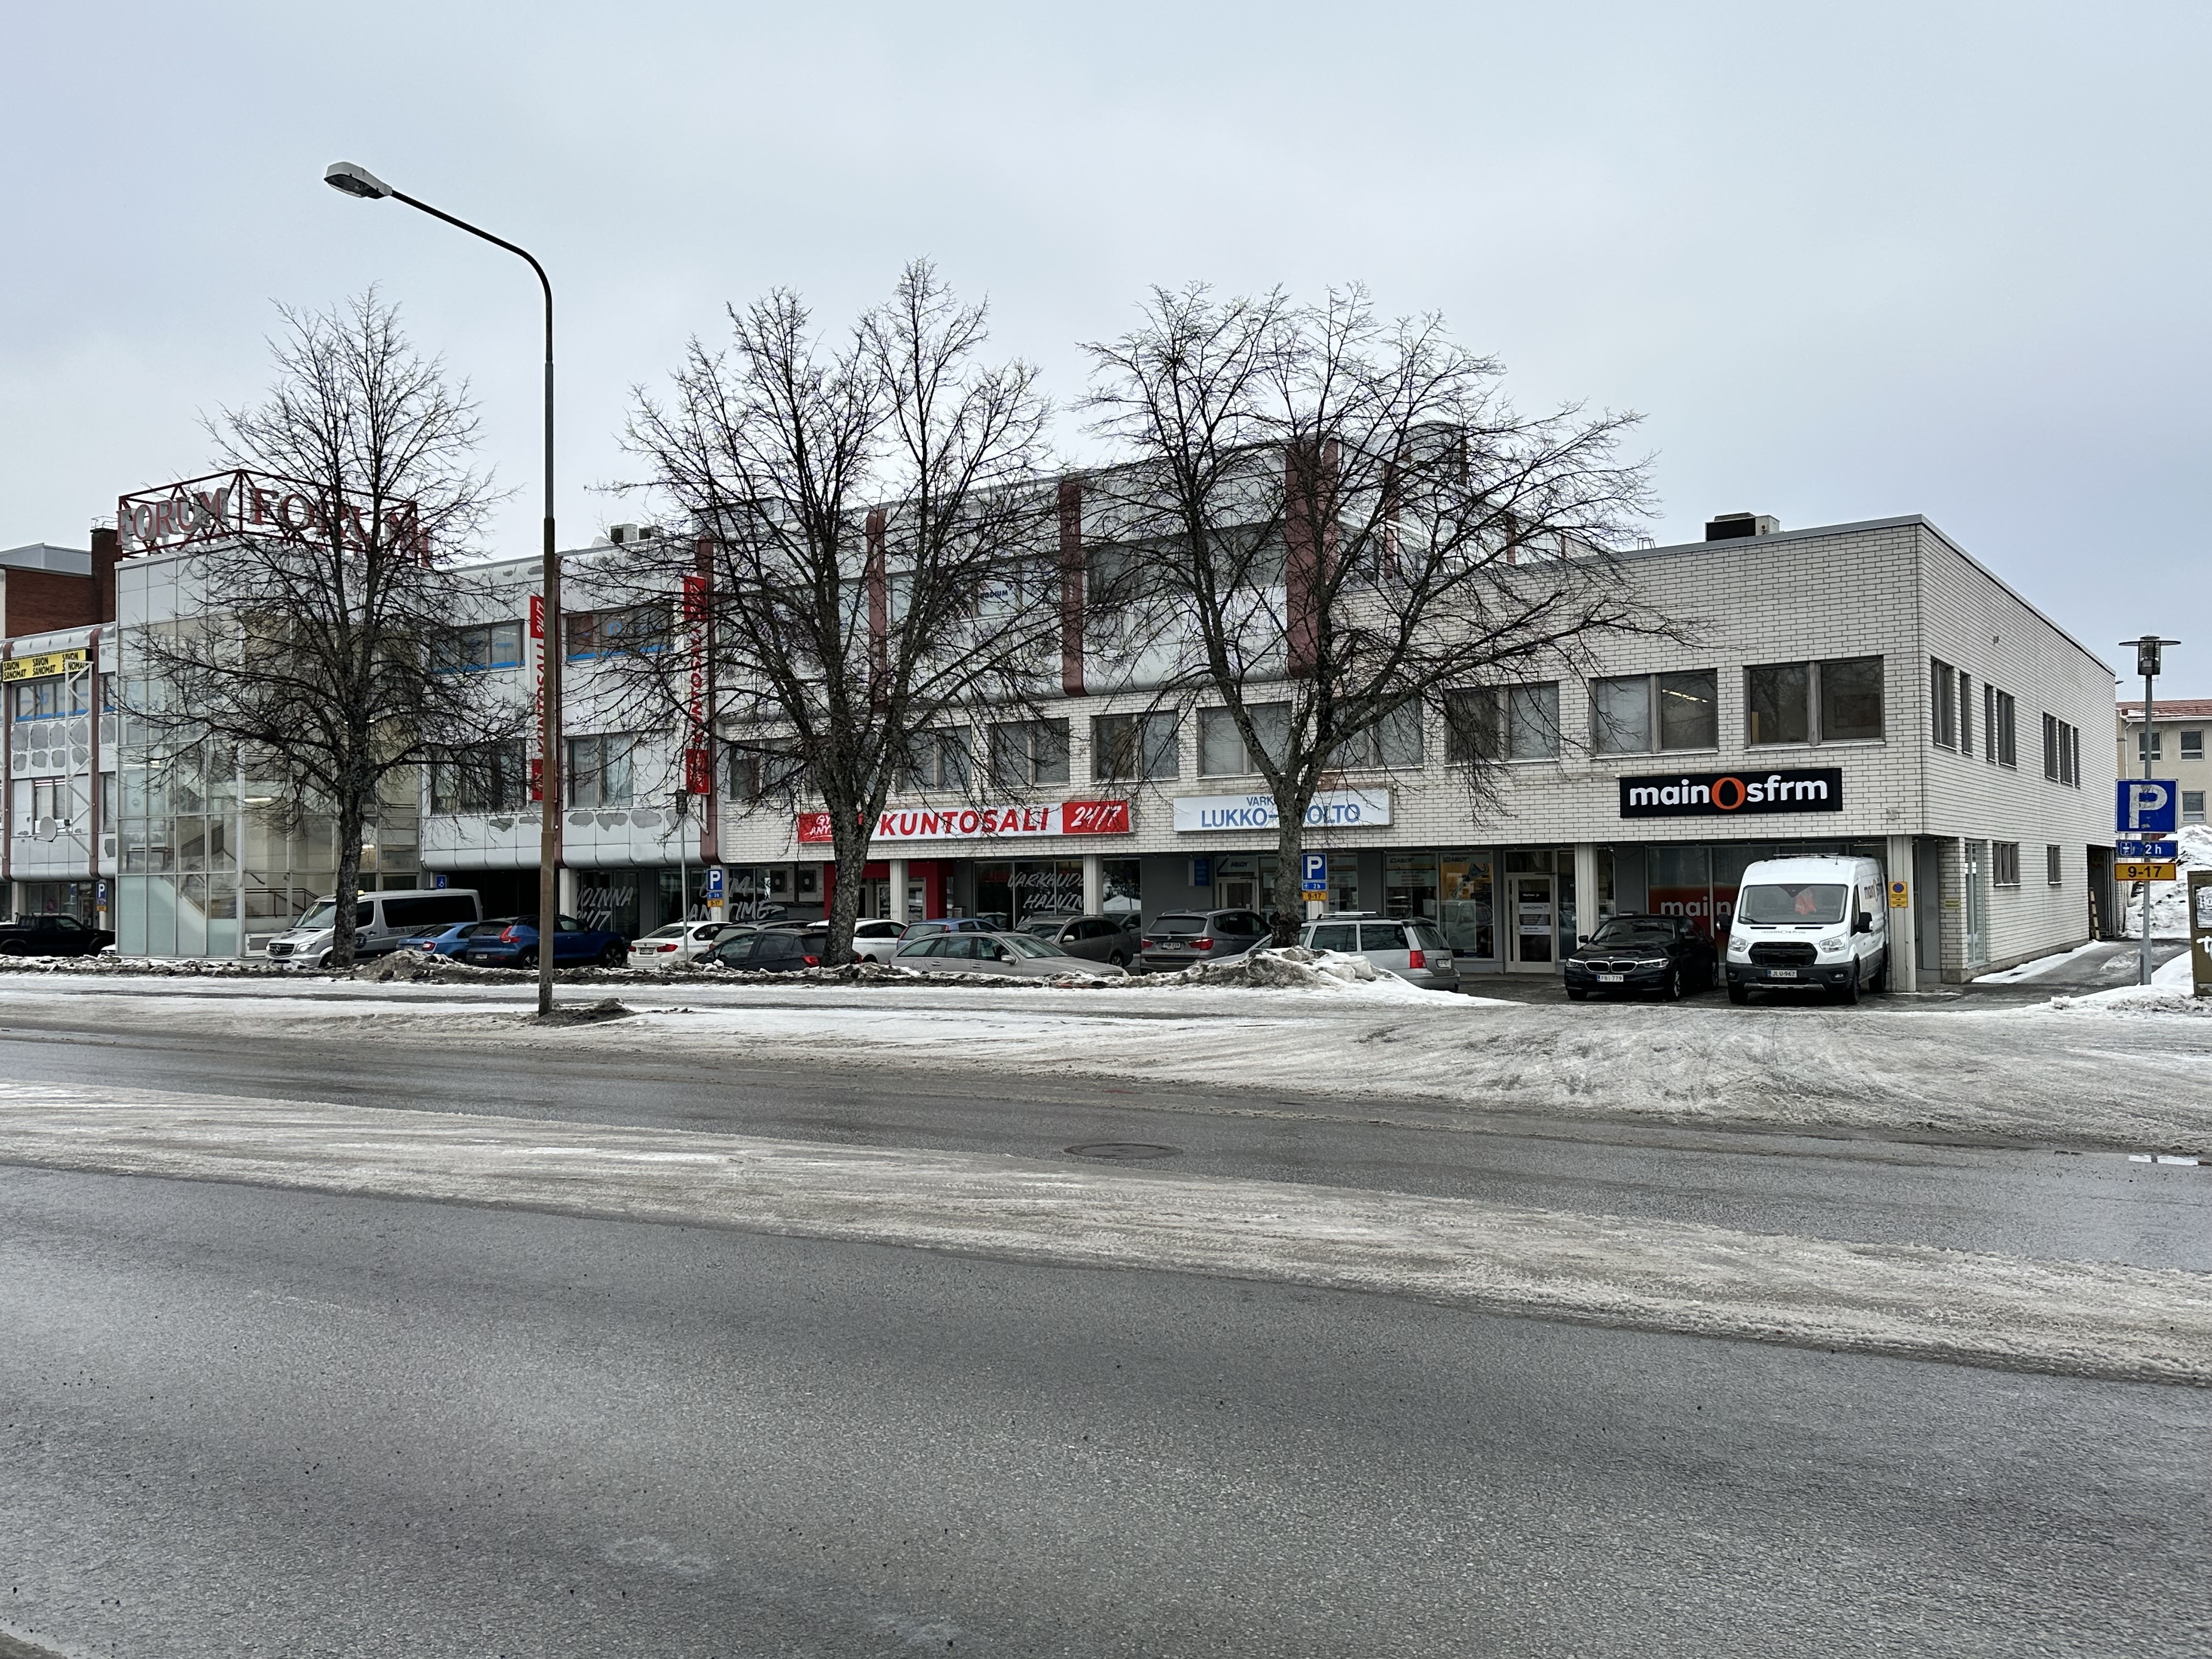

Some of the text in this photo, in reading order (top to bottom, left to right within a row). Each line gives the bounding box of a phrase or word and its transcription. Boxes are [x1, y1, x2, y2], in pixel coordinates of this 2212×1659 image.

[116, 488, 230, 546] FORUM
[3, 661, 19, 671] SAVON
[32, 656, 49, 667] SAVON
[32, 664, 56, 676] SANOMAT
[3, 669, 27, 680] SANOMAT
[1246, 795, 1275, 806] VARK
[1630, 775, 1827, 810] mainOsfrm
[1201, 803, 1361, 827] LUKKO-OLTO
[2129, 785, 2168, 828] P
[816, 815, 831, 827] GY
[879, 808, 1049, 837] KUNTOSALI
[1071, 804, 1122, 831] 24/7
[804, 826, 832, 836] ANY
[1307, 856, 1323, 878] P
[2128, 866, 2162, 877] 9-17
[710, 871, 720, 889] P
[99, 883, 105, 898] P
[681, 900, 785, 921] ANTIME
[1661, 896, 1737, 917] main
